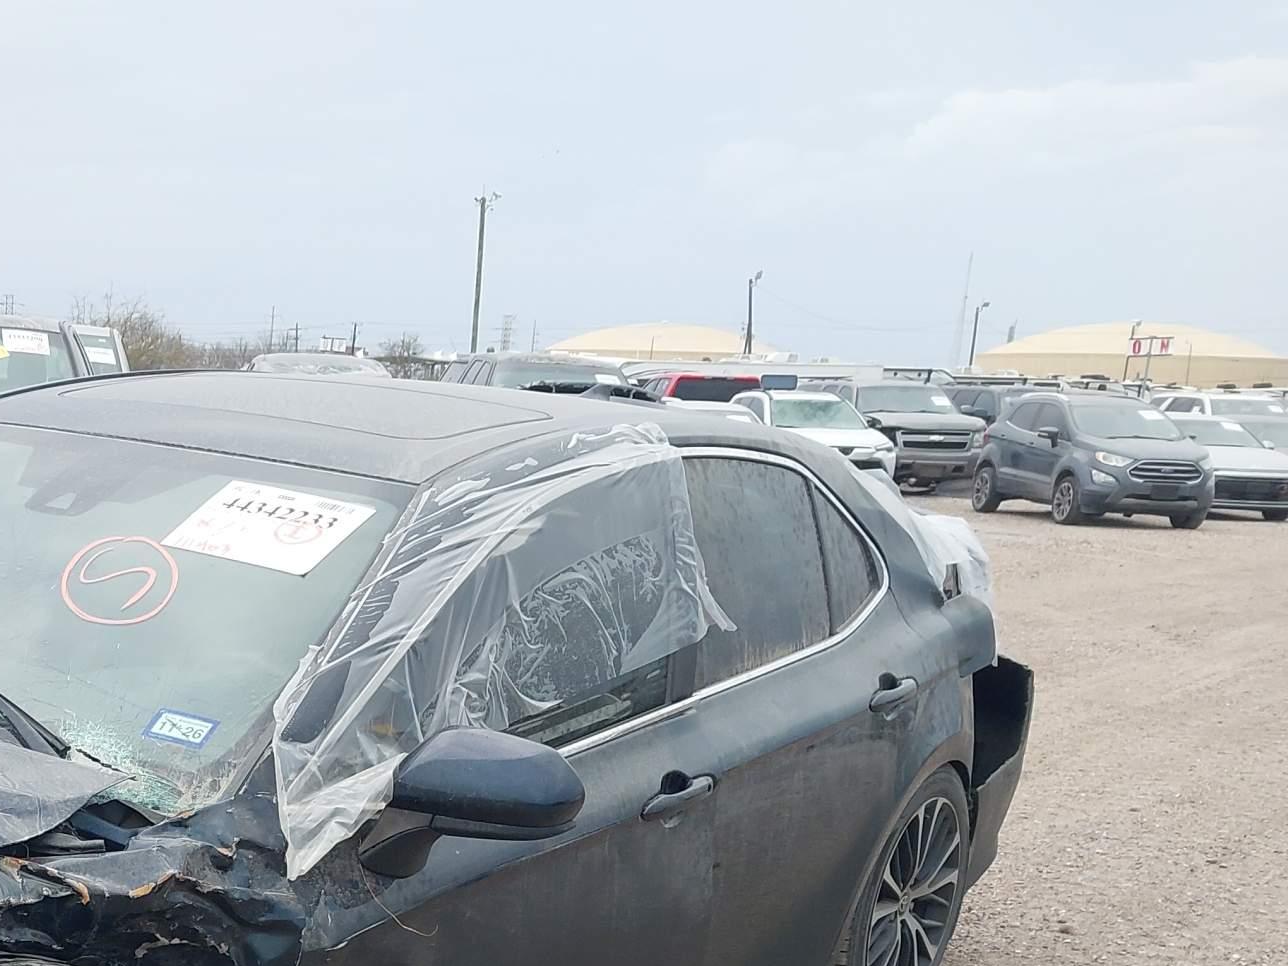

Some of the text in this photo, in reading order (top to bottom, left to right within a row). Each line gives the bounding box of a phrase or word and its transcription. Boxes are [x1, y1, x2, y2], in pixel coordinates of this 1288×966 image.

[1160, 339, 1170, 353] N
[221, 497, 339, 529] 44342233
[184, 726, 205, 739] 26
